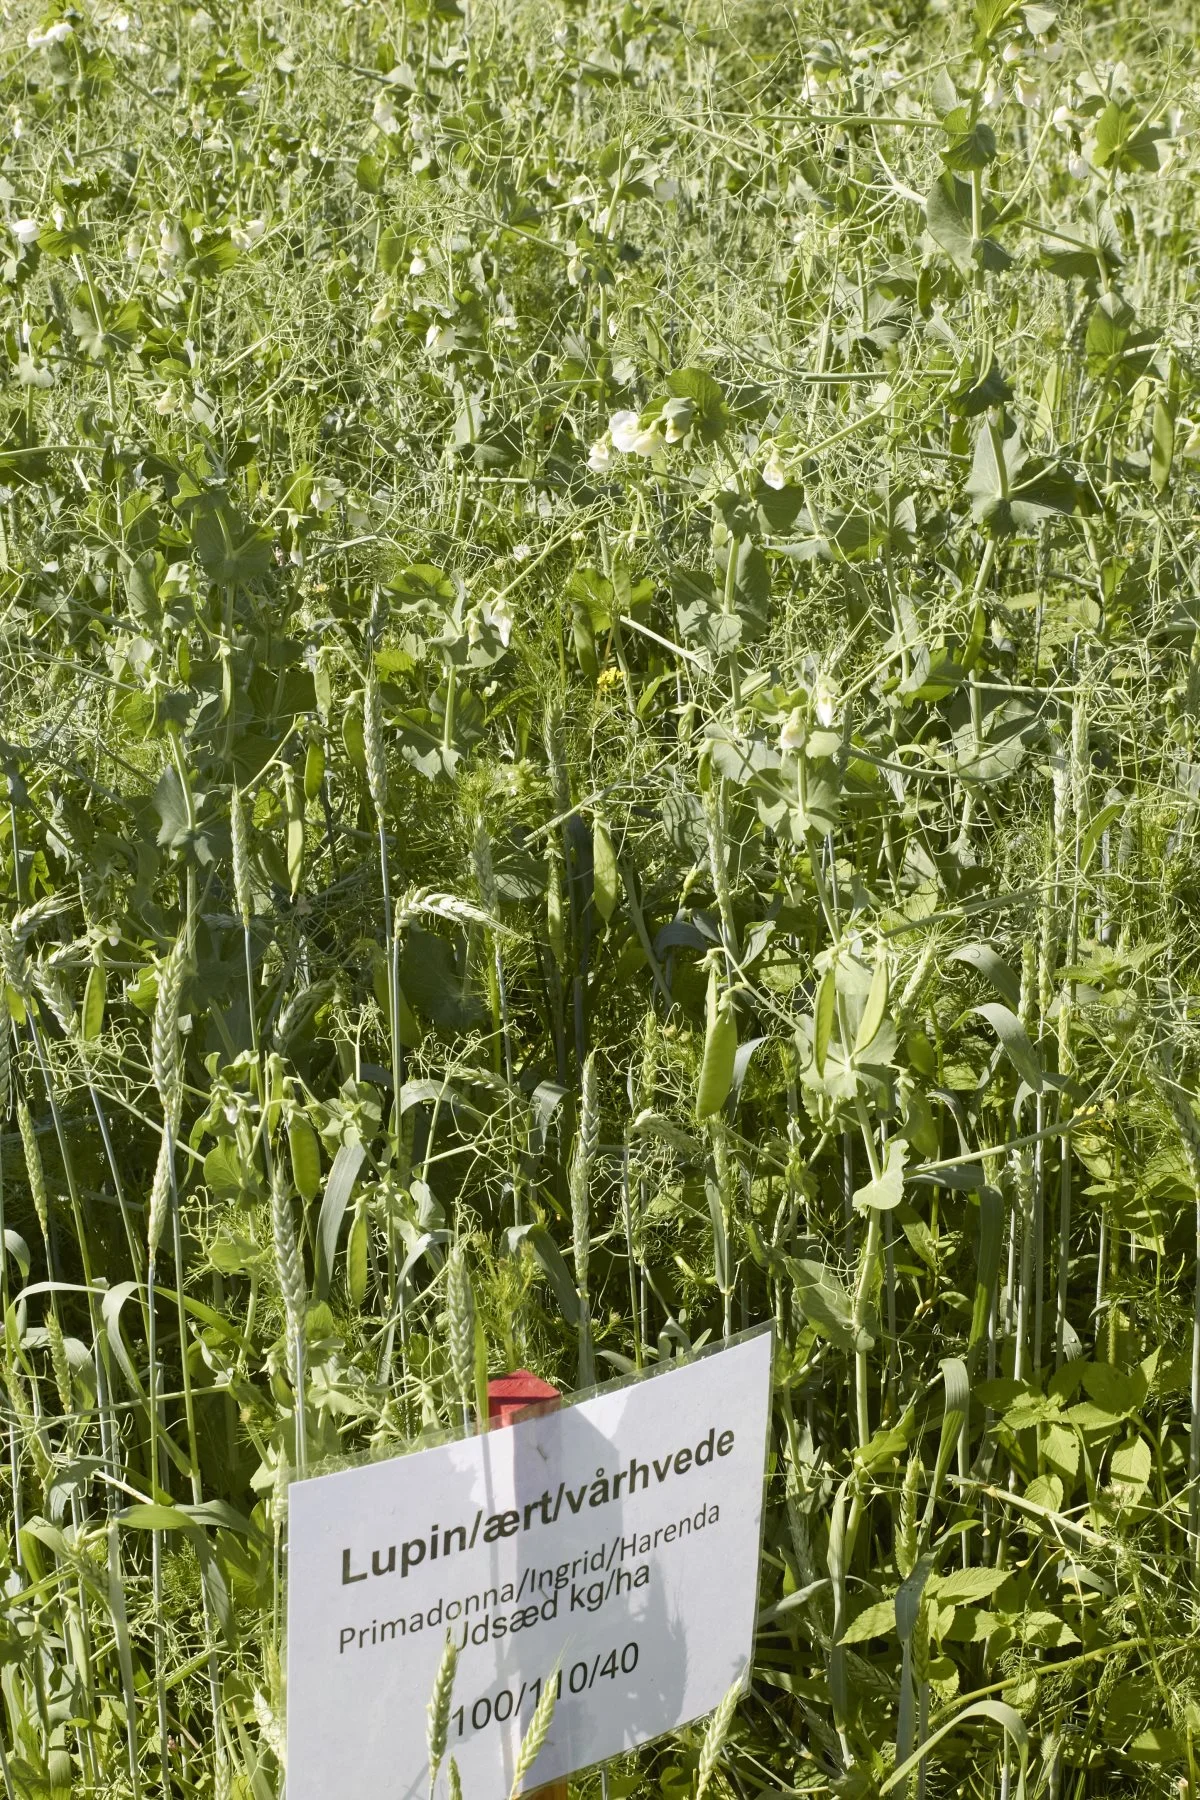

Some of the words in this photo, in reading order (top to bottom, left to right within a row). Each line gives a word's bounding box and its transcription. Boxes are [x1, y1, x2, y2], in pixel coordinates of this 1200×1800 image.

[341, 1428, 735, 1586] Lupin/ært/vårhvede
[338, 1502, 721, 1655] Primadonna/Ingrid/Harenda
[570, 1564, 651, 1613] kg/ha
[452, 1641, 640, 1737] 100/110/40
